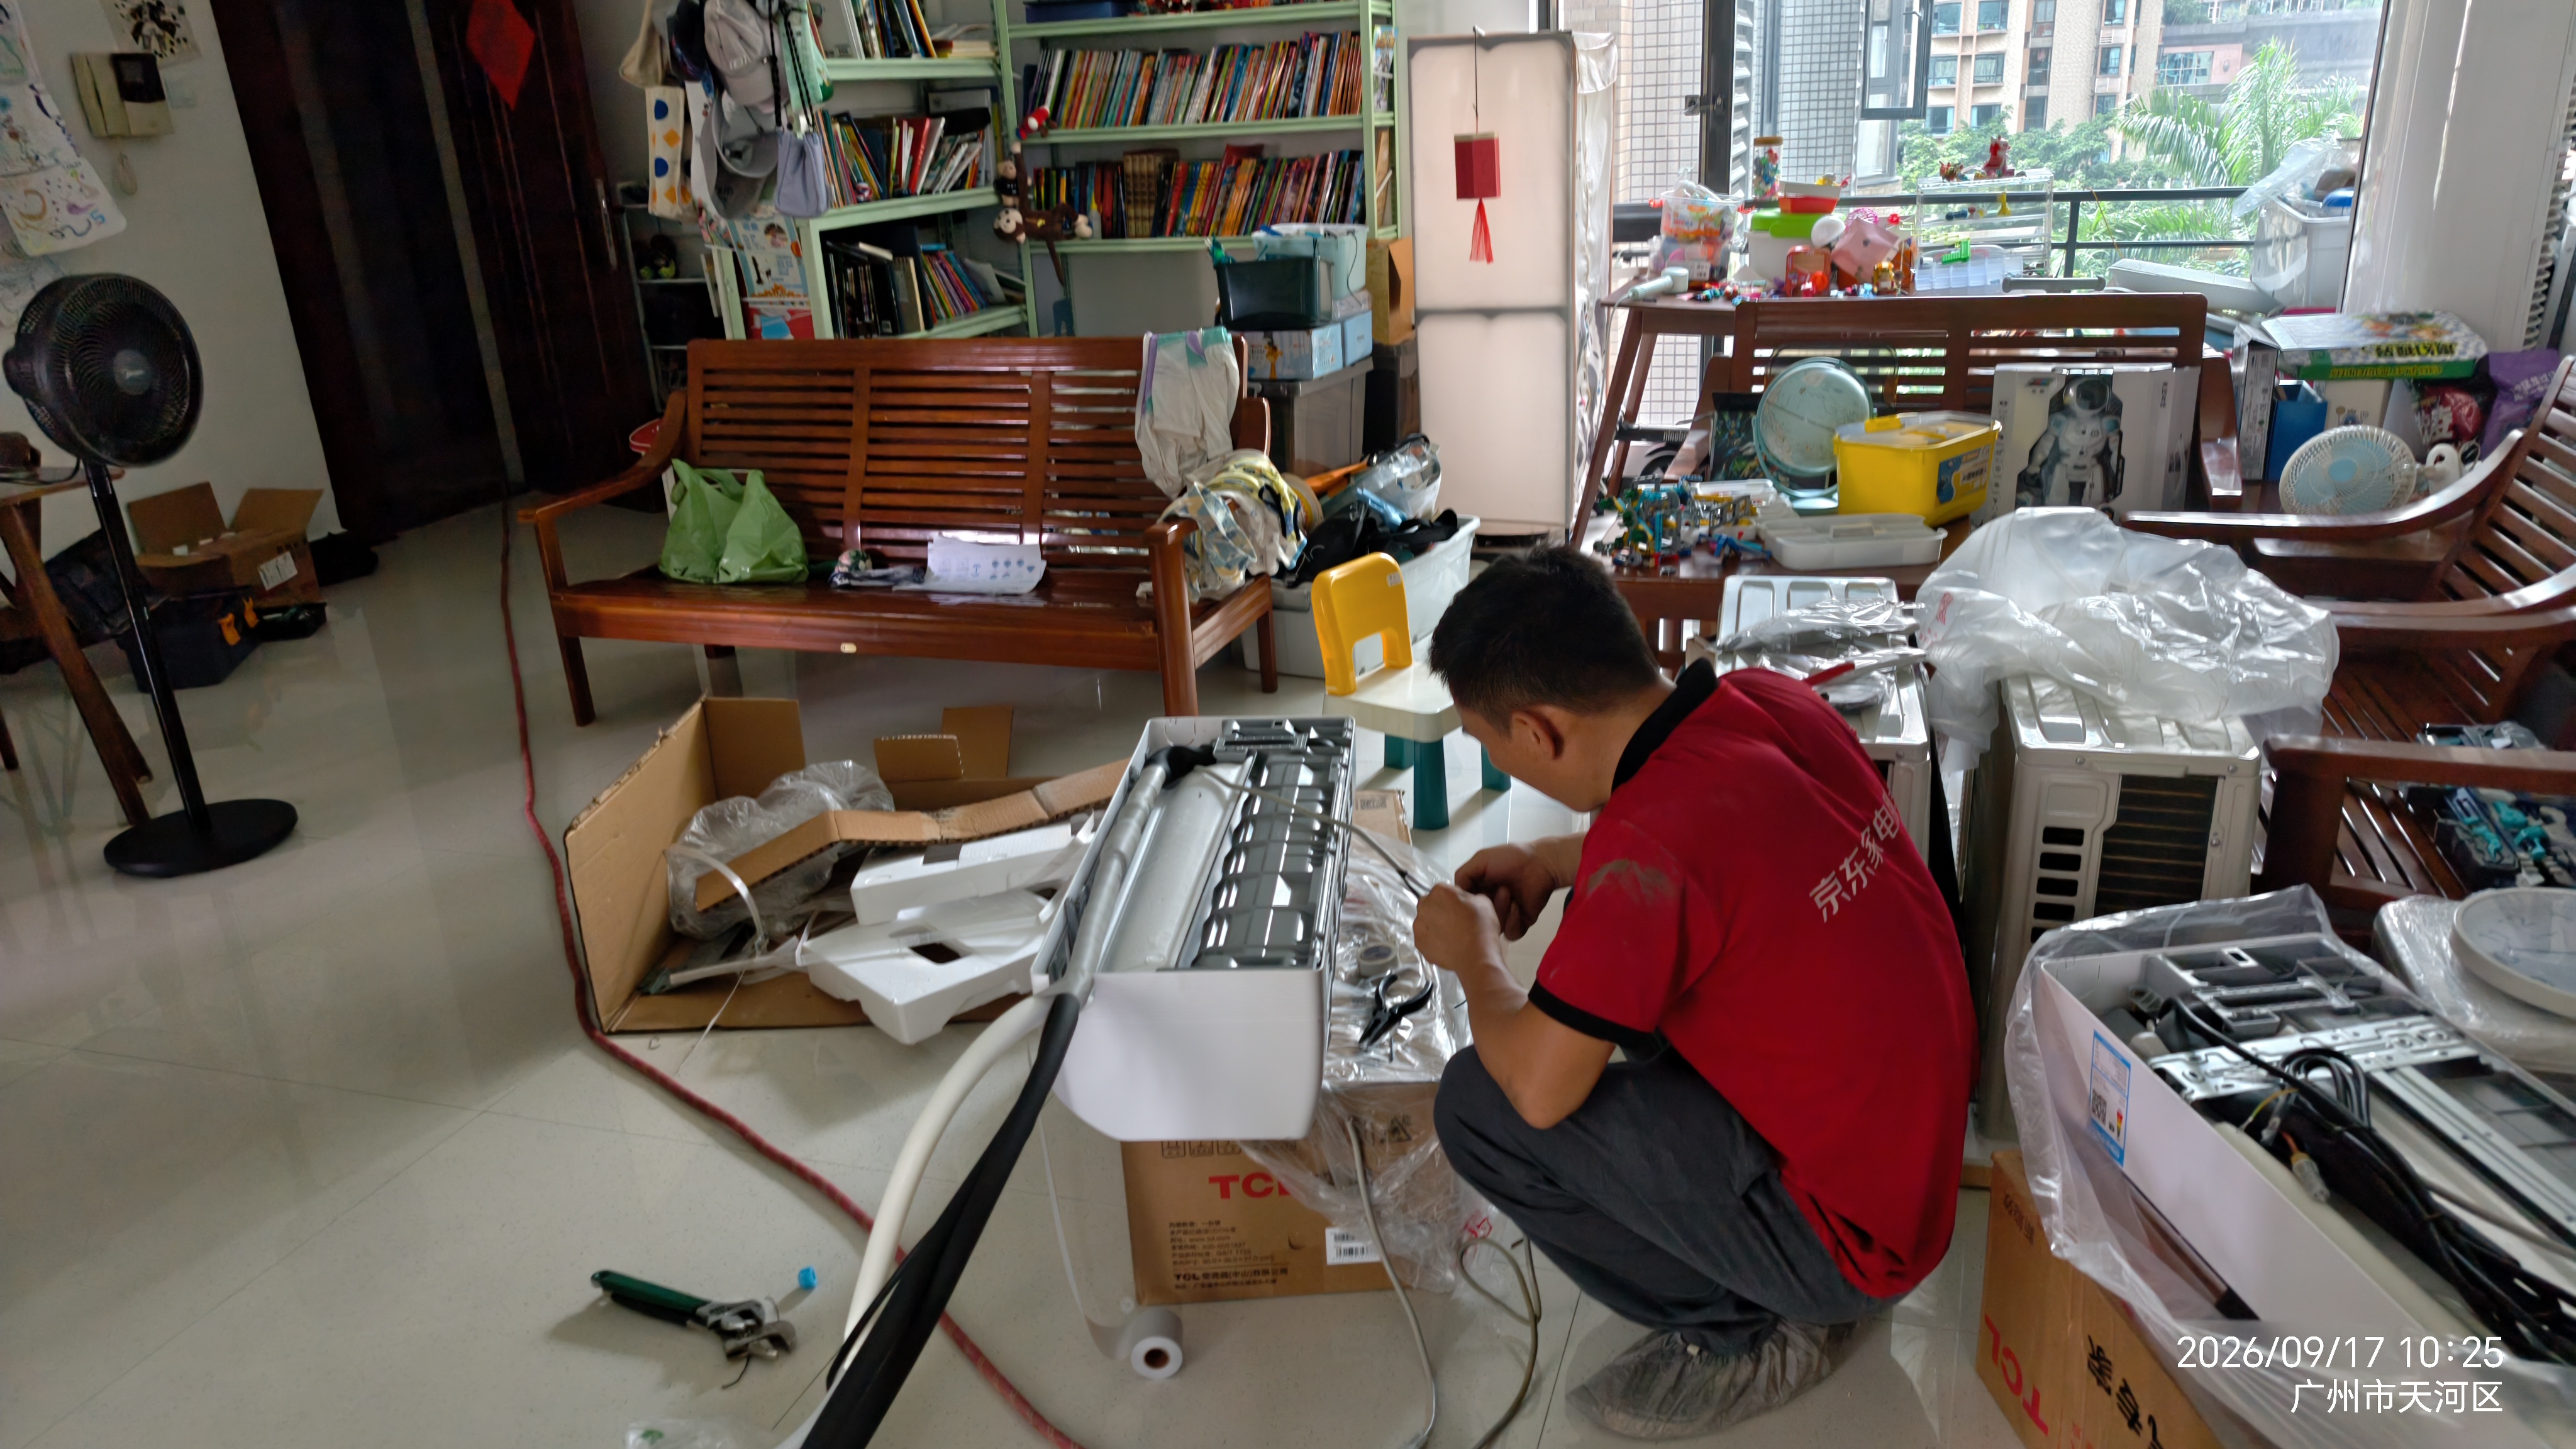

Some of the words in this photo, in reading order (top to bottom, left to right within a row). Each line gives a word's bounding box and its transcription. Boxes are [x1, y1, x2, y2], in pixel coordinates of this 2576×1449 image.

[1809, 804, 1900, 923] 京东家电
[1984, 1313, 2048, 1437] TCL
